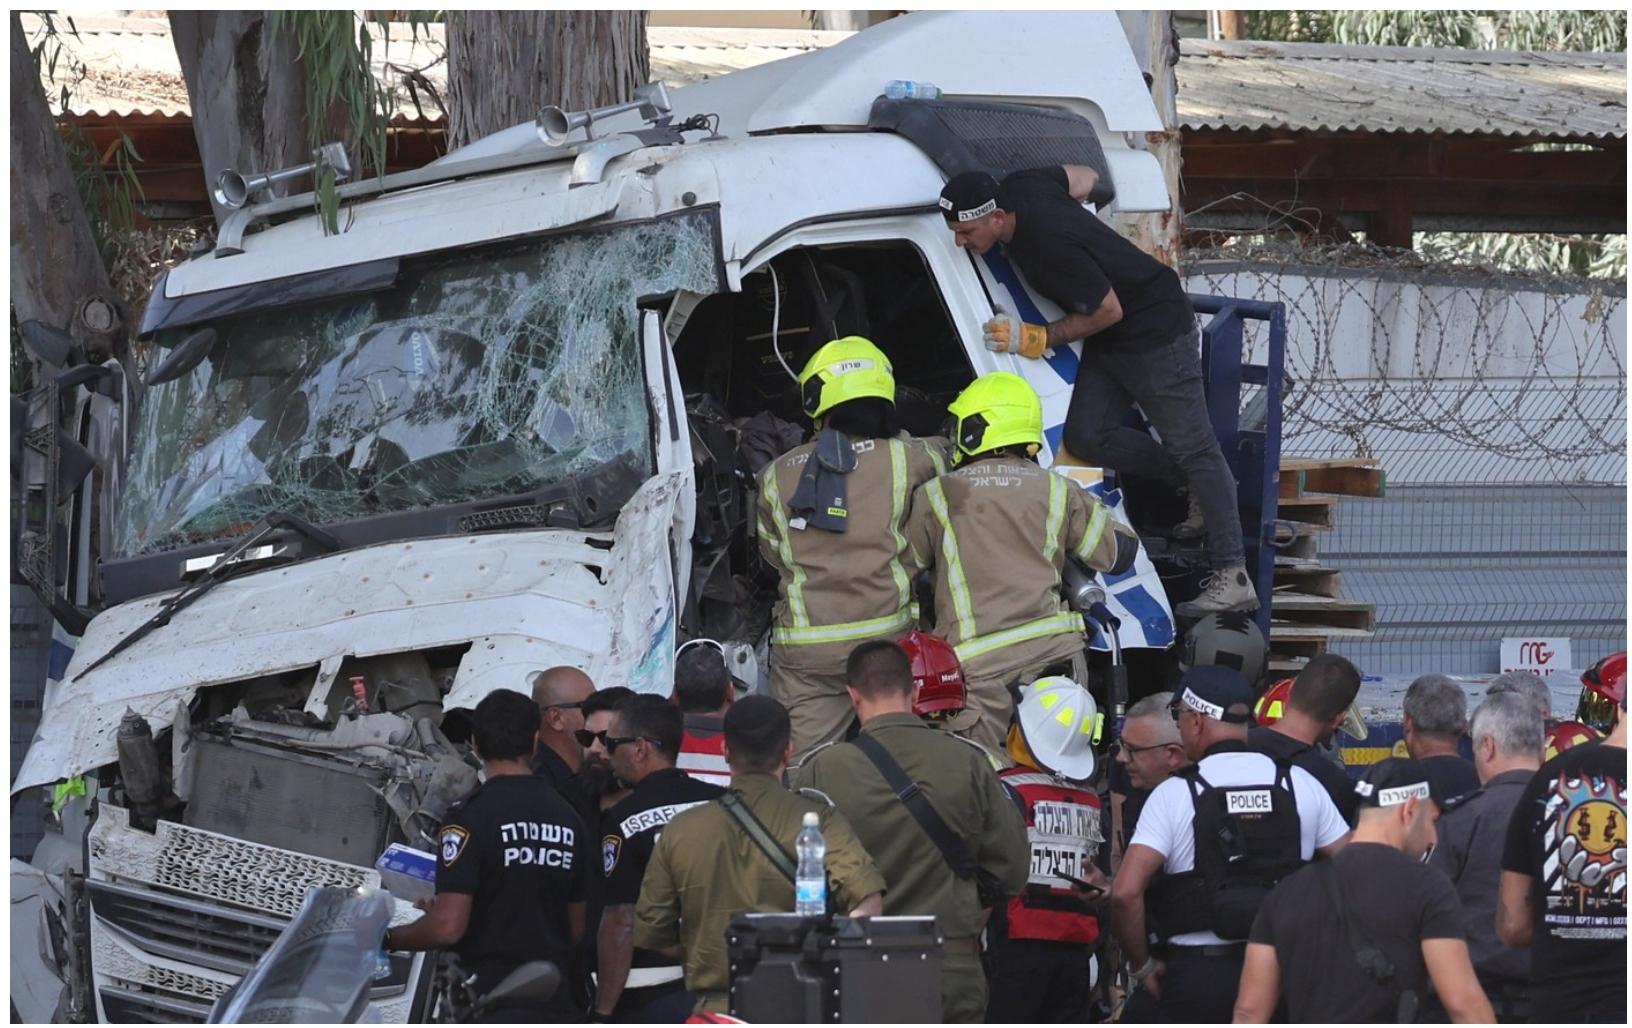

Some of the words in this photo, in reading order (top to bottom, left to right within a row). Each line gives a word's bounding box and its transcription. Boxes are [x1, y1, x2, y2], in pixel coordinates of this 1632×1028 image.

[961, 202, 995, 219] משטרה
[1185, 691, 1219, 717] POLICE
[1231, 794, 1269, 809] POLICE
[1382, 786, 1427, 803] משטרה
[1037, 803, 1073, 835] והצלה
[501, 821, 575, 847] משטרה
